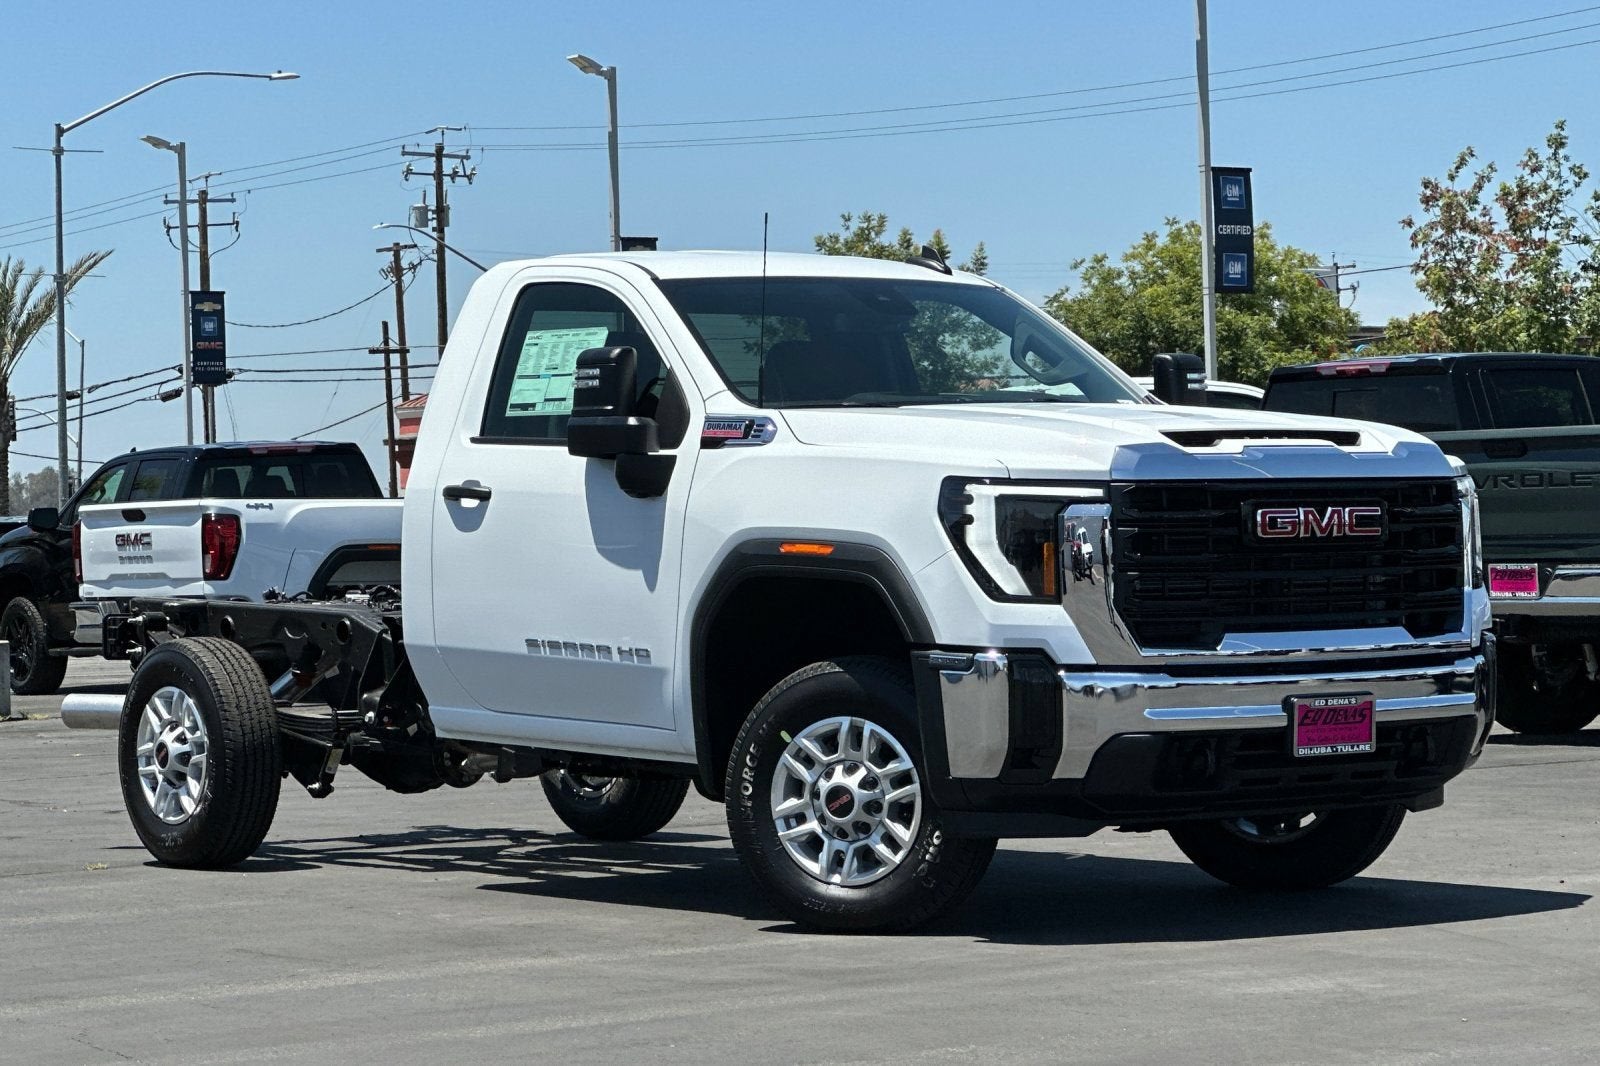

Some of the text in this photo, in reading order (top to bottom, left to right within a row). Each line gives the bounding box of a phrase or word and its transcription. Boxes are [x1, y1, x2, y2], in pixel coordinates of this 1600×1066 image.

[1226, 183, 1240, 201] GM
[1218, 224, 1252, 235] CERTIFIED
[1228, 260, 1241, 278] GM
[196, 341, 224, 350] GMC
[706, 422, 743, 431] DURAMAX
[1473, 467, 1600, 490] VROLE
[1257, 506, 1382, 537] GMC
[115, 532, 152, 547] GMC
[617, 645, 651, 661] HD
[1299, 744, 1371, 755] DINUBA TULARE
